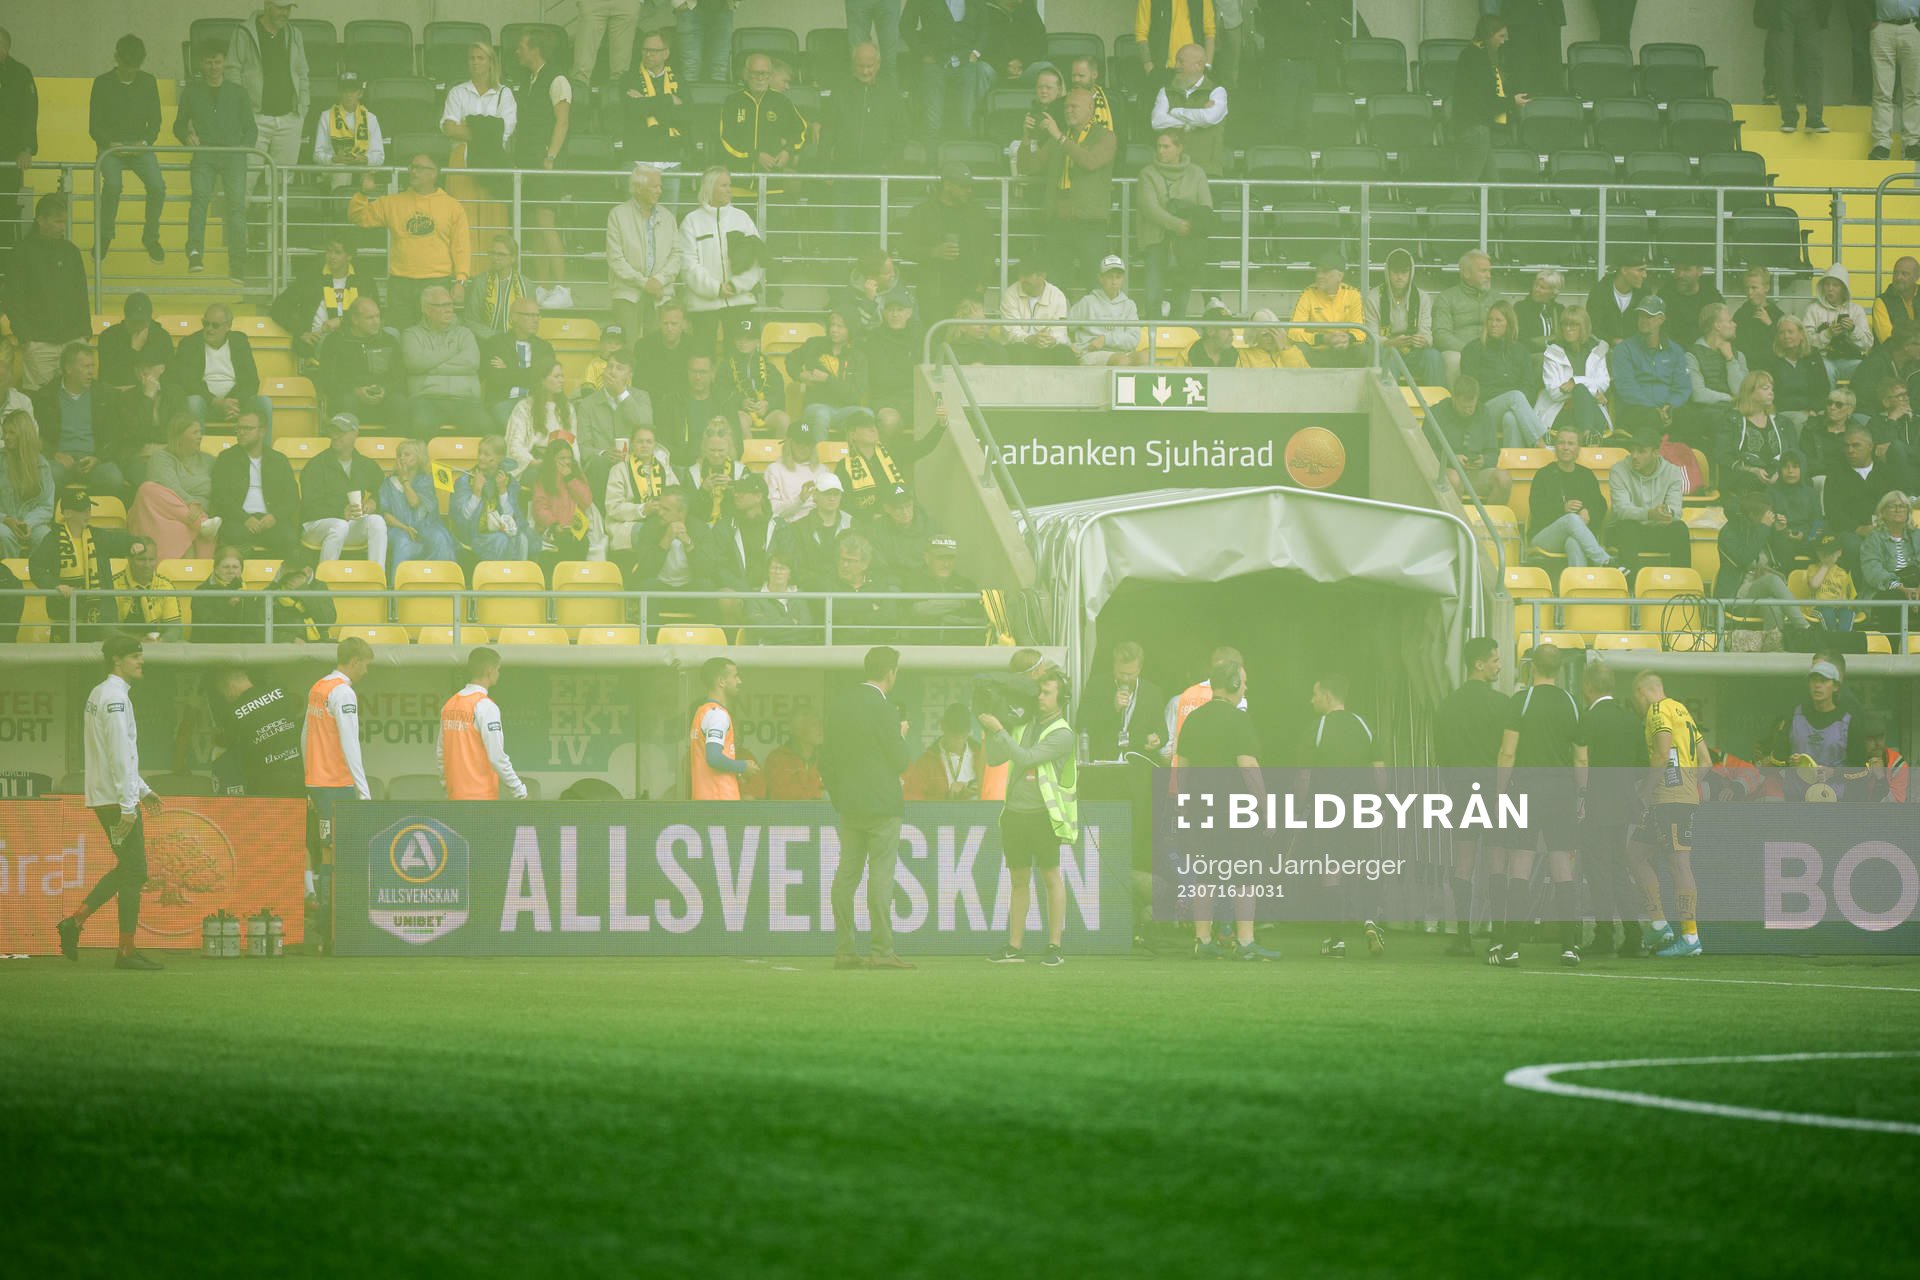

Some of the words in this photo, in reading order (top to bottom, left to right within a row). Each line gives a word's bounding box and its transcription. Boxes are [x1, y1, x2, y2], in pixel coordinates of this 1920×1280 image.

[976, 438, 1135, 465] arbanken
[1146, 440, 1273, 473] Sjuhärad
[234, 688, 285, 720] SERNEKE
[548, 704, 629, 734] EKT
[378, 888, 460, 904] ALLSVENSKAN
[1764, 841, 1920, 931] BO
[394, 916, 442, 927] UNIBET
